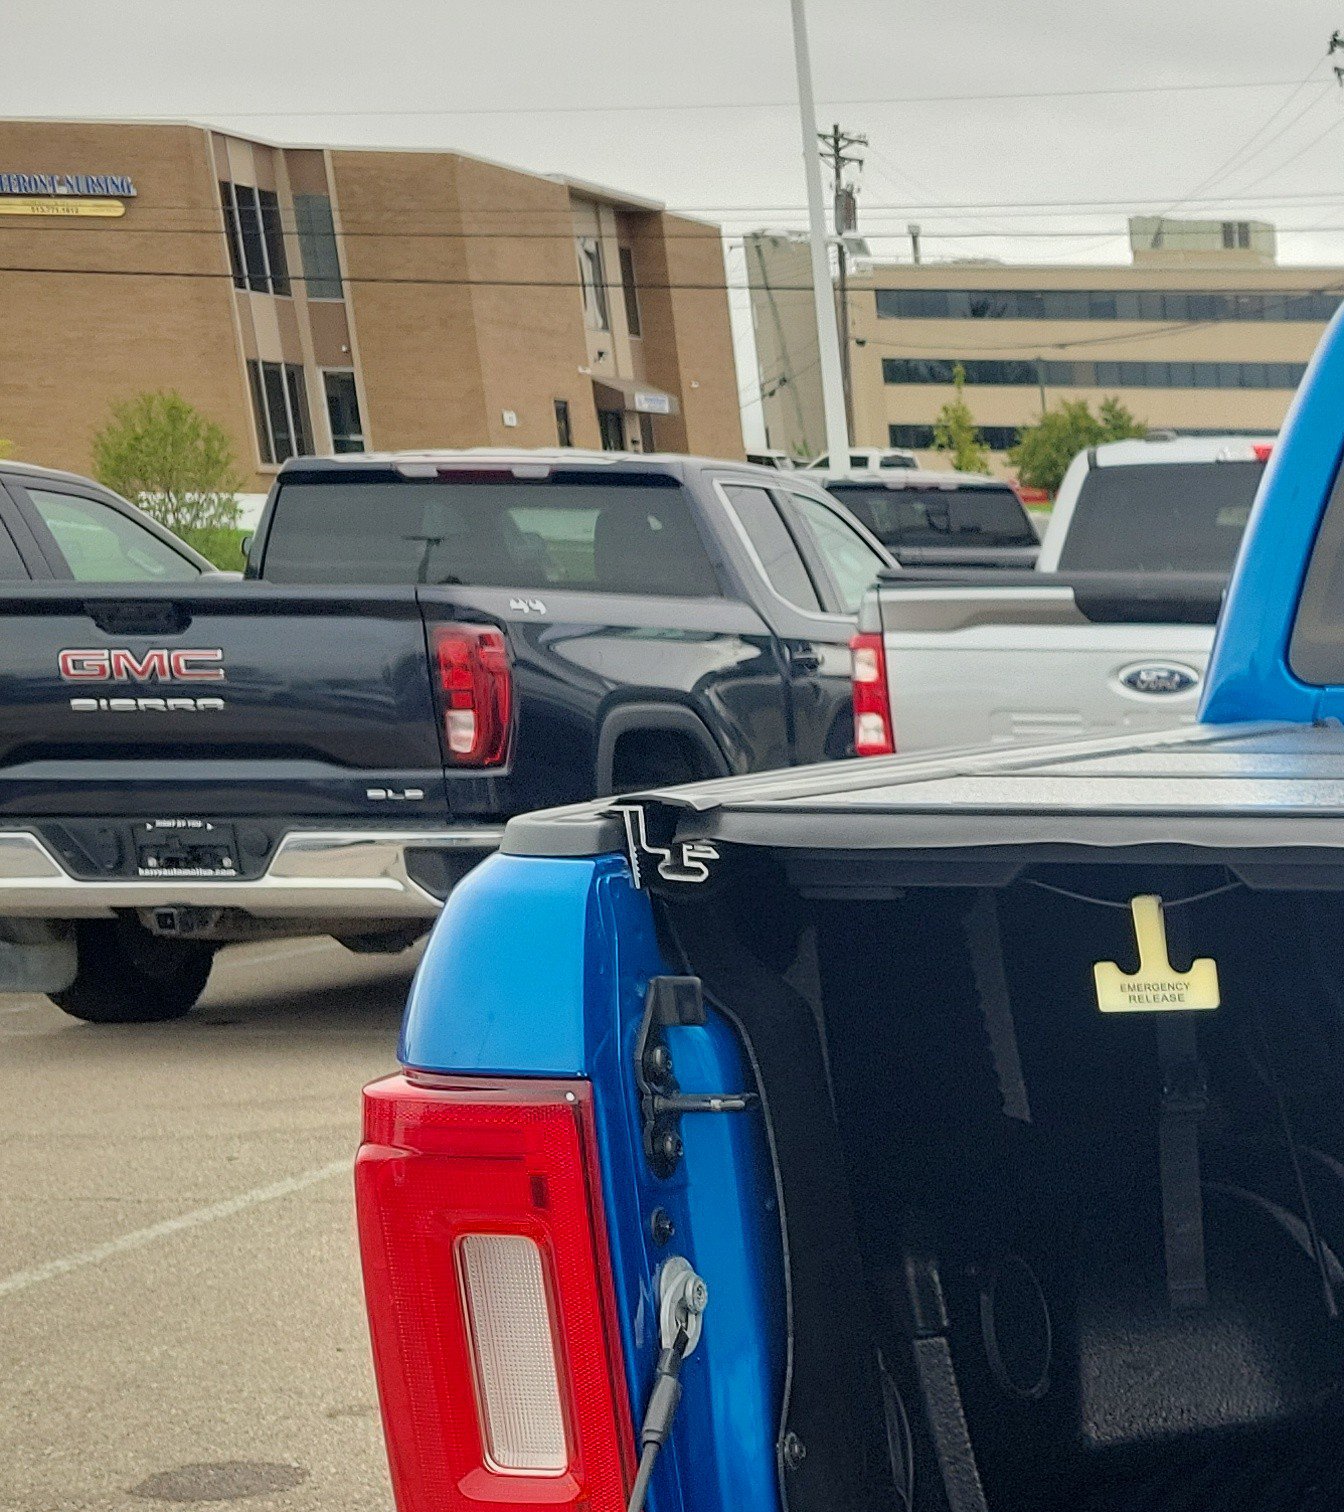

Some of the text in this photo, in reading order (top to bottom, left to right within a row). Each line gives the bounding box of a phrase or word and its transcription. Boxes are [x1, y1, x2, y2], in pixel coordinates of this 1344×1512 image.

[64, 174, 133, 195] NURSING
[58, 648, 226, 681] GMC
[69, 698, 225, 712] SIERRA
[1120, 982, 1191, 993] EMERGENCY
[1128, 993, 1186, 1004] RELEASE
